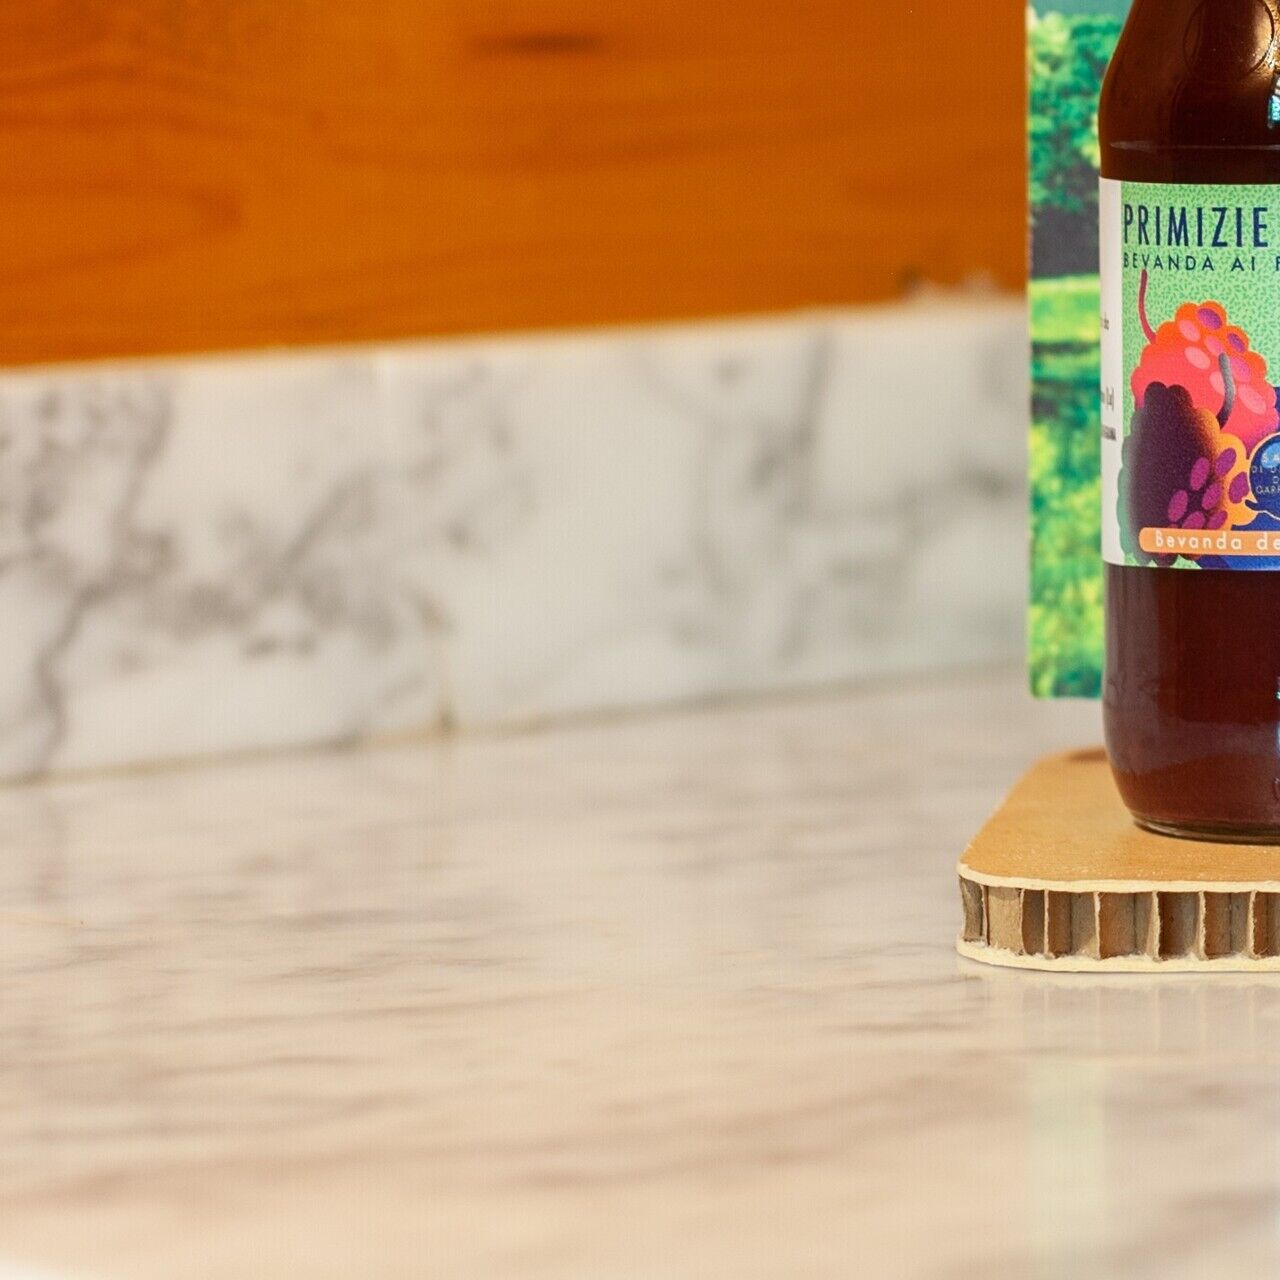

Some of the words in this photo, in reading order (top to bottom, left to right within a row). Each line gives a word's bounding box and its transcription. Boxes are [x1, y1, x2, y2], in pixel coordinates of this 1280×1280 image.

[1124, 204, 1269, 247] PRIMIZIE
[1123, 252, 1214, 271] BEVANDA
[1231, 254, 1255, 271] AI
[1155, 530, 1242, 551] Bevanda
